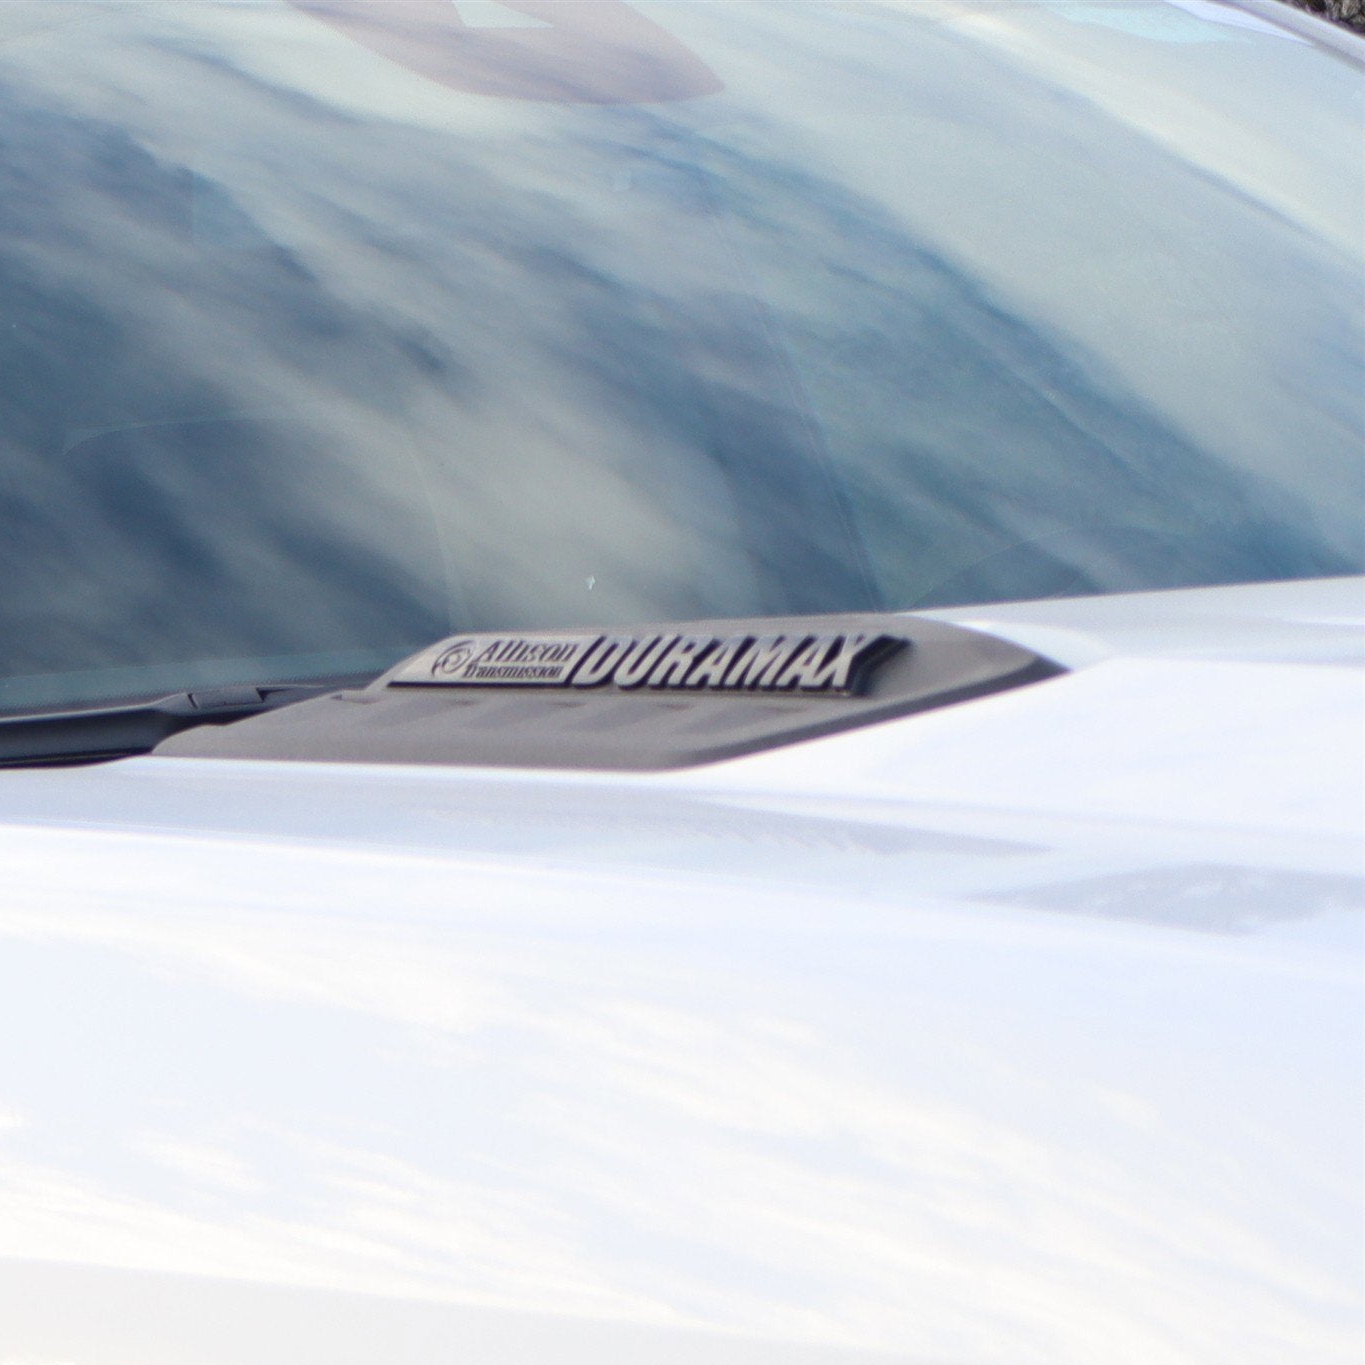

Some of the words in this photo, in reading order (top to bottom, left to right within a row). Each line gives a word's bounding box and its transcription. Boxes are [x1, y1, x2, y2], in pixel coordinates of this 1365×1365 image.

[471, 640, 581, 664] Allison
[568, 633, 881, 691] DURAMAX
[461, 663, 566, 680] Transmission
